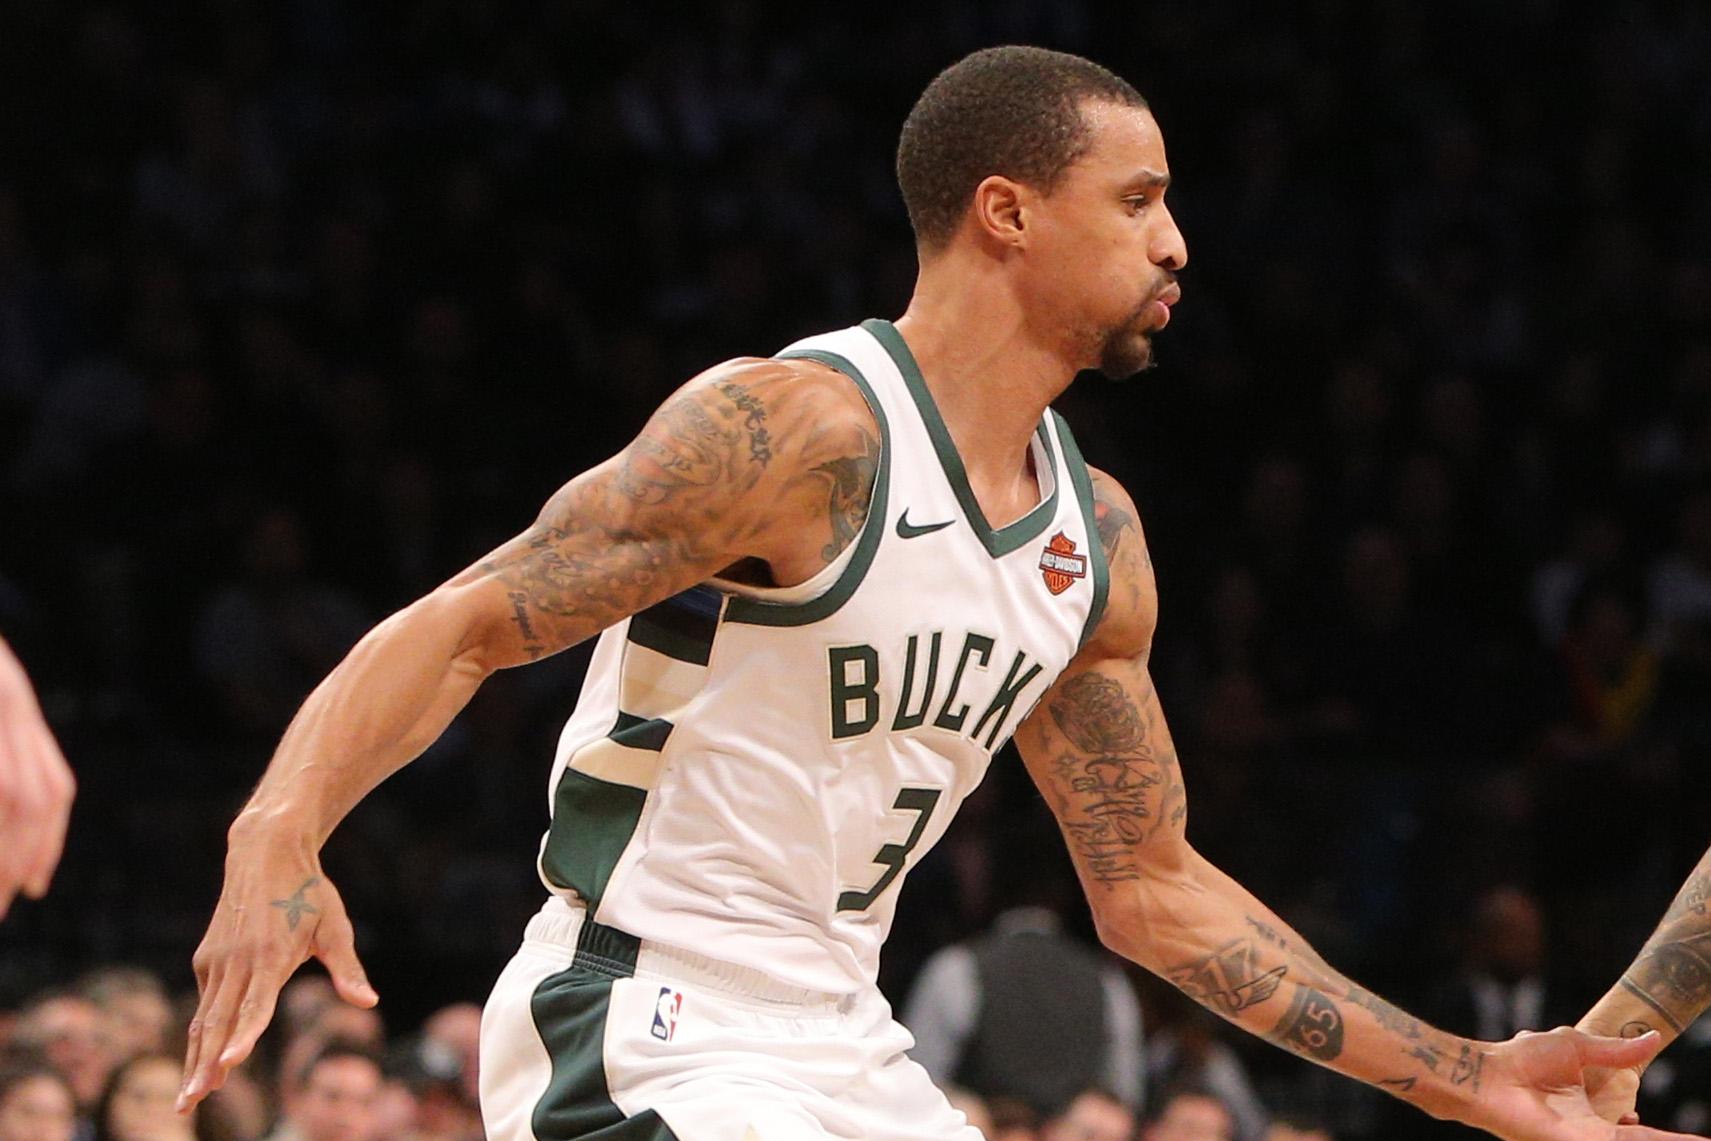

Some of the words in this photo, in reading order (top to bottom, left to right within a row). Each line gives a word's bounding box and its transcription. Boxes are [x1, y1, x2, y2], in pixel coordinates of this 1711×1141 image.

[828, 631, 1045, 751] BUCK
[836, 787, 943, 913] 3
[1301, 1001, 1339, 1048] 65
